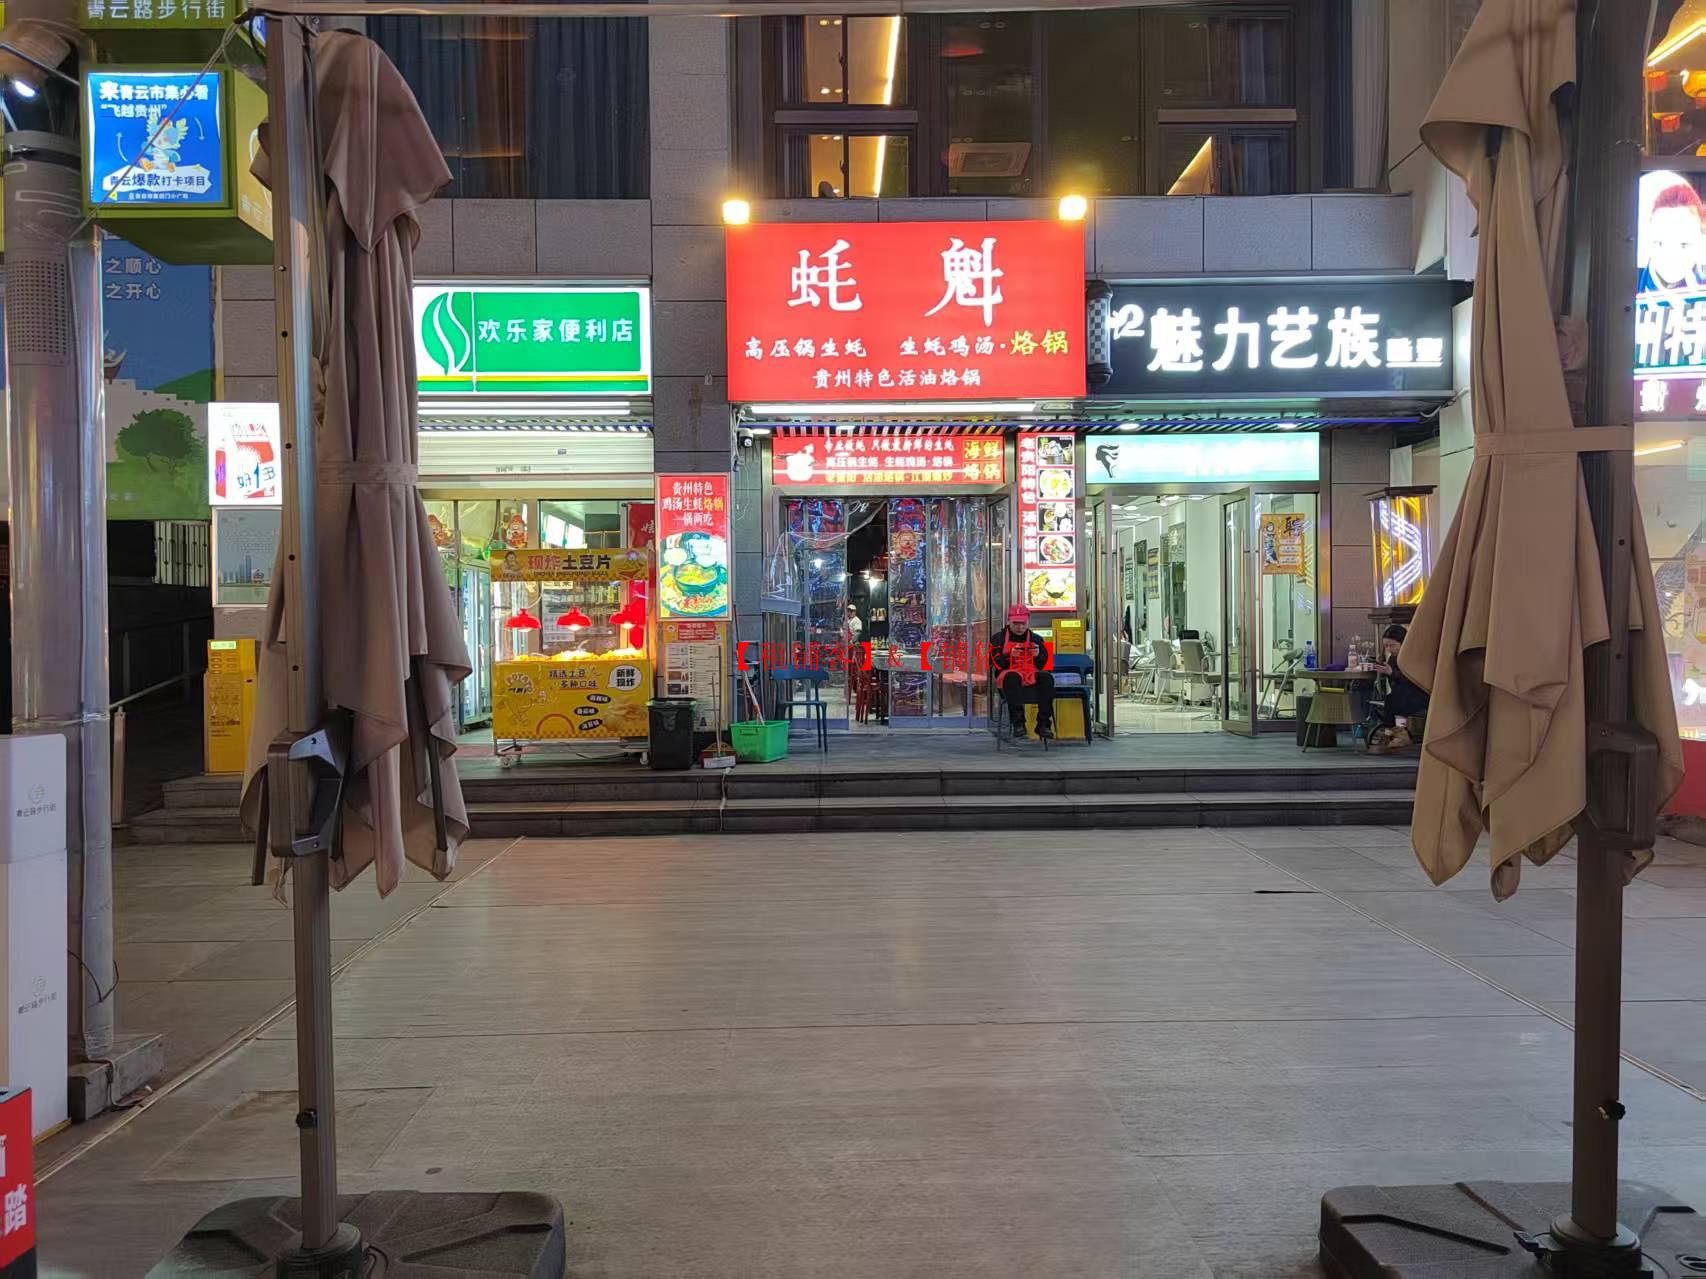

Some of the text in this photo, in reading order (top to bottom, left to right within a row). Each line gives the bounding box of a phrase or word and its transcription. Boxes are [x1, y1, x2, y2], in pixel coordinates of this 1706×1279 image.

[87, 0, 225, 19] 青云路步行街
[105, 257, 162, 275] 之顺心
[106, 282, 162, 300] 之开心
[923, 236, 1004, 328] 魁
[477, 318, 633, 343] 欢乐家便利店
[1147, 306, 1383, 372] 魅力艺族
[744, 335, 868, 360] 高压锅生蚝
[812, 367, 982, 389] 贵州特色活油烙锅
[964, 440, 1001, 459] 海鲜
[527, 554, 612, 571] 现炸土豆片
